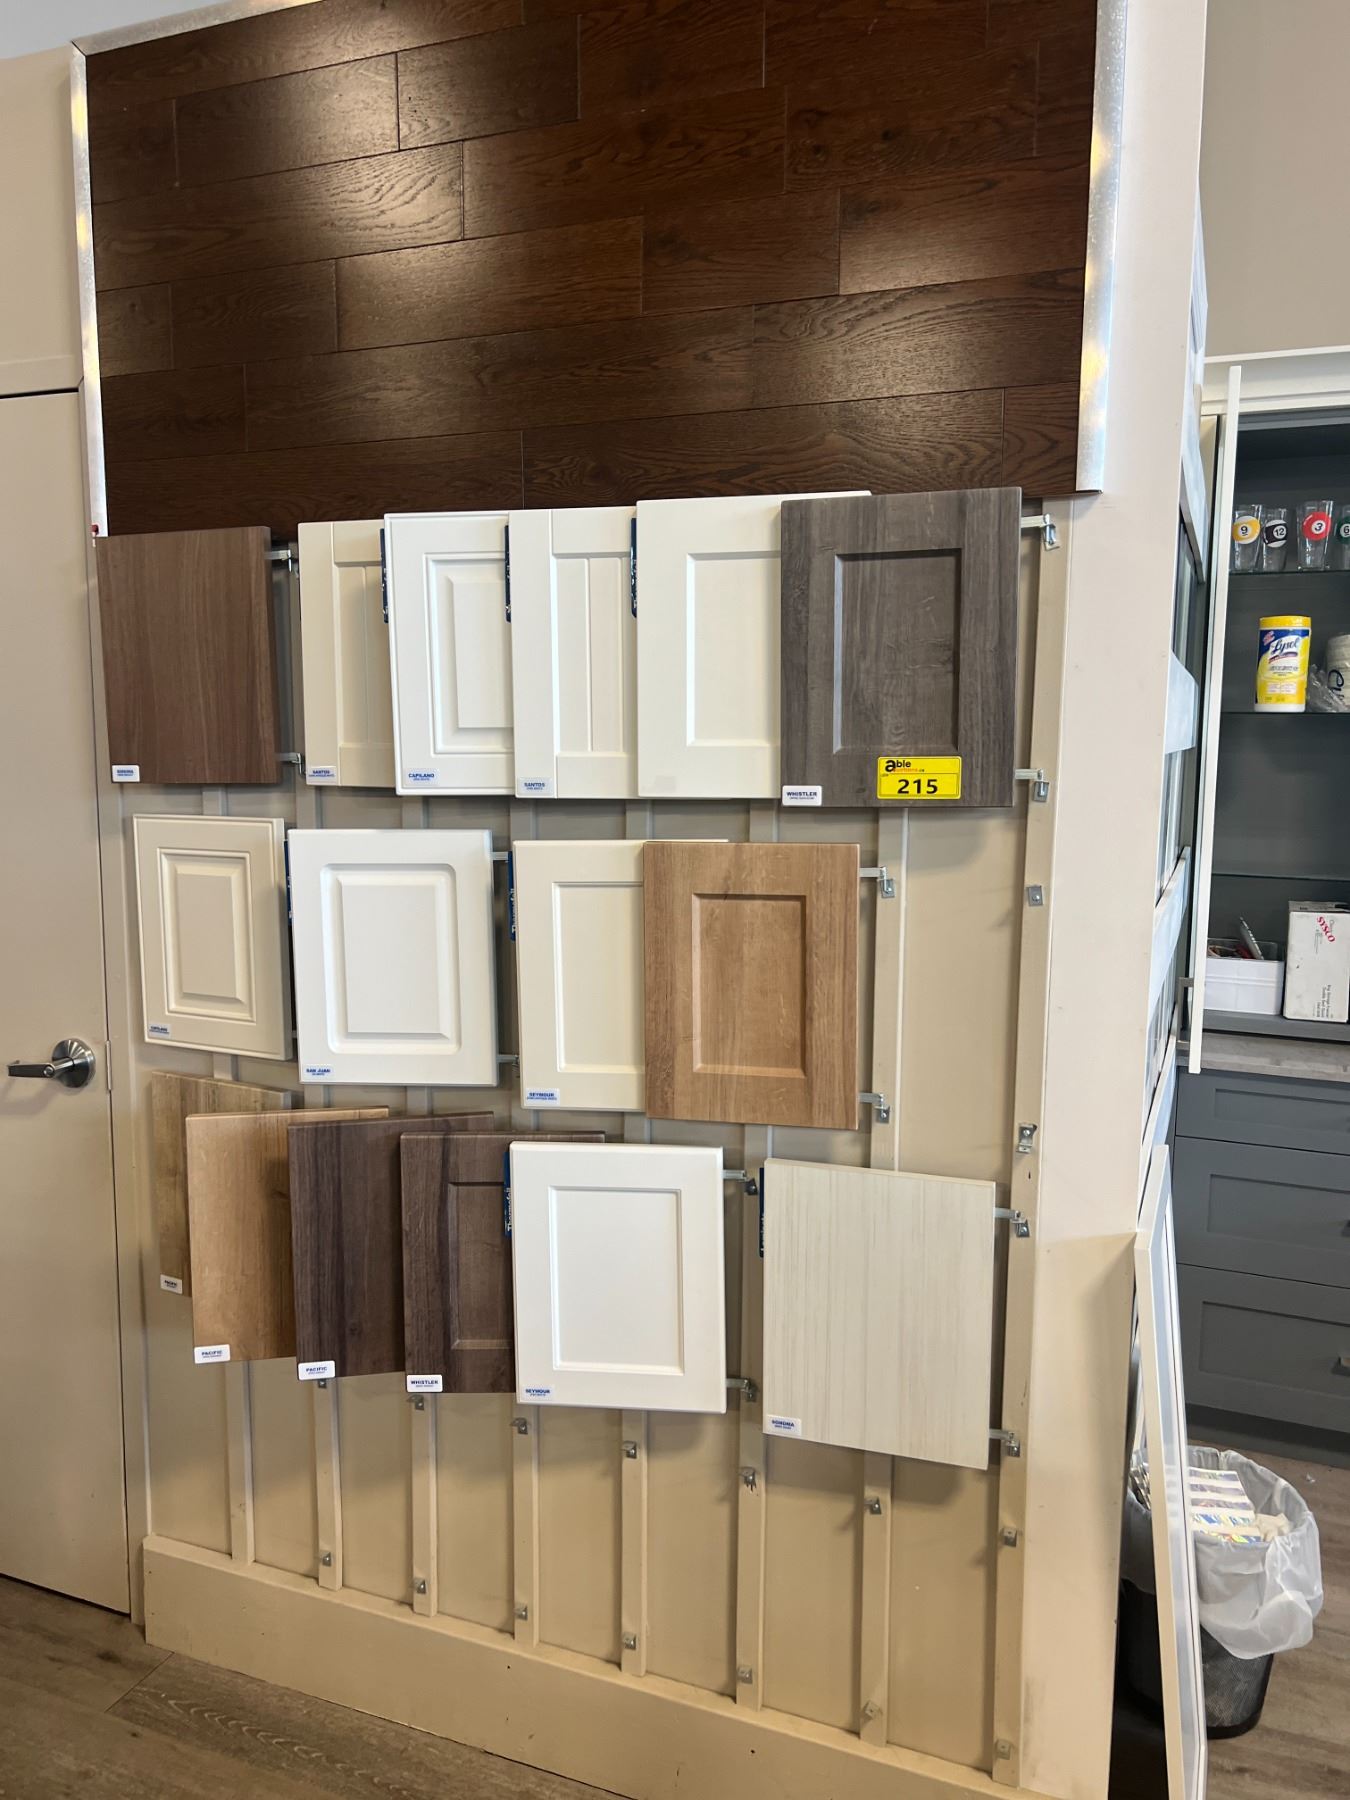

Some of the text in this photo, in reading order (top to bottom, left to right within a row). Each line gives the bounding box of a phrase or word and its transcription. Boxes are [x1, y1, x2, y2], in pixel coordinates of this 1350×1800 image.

[1240, 525, 1248, 536] 9
[1274, 527, 1285, 537] 12
[1314, 522, 1323, 532] 3
[1343, 525, 1350, 535] 6
[1271, 638, 1300, 654] Lysol
[897, 778, 938, 794] 215
[1316, 916, 1336, 942] SYSCO
[772, 1419, 795, 1427] SONOMA
